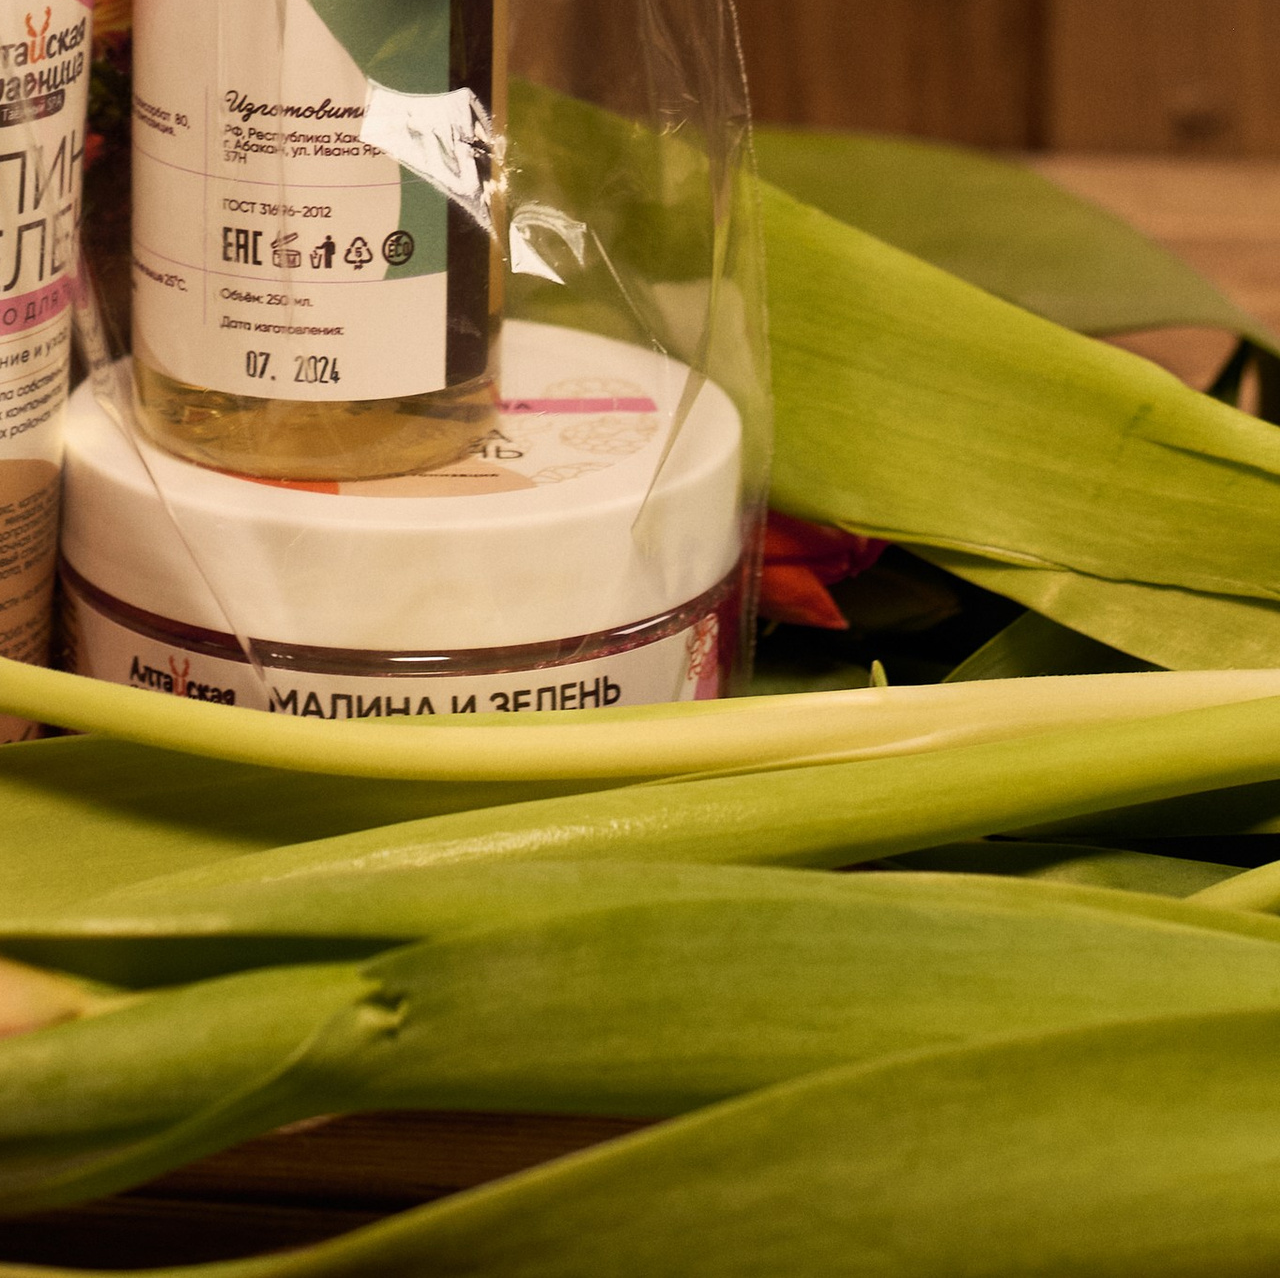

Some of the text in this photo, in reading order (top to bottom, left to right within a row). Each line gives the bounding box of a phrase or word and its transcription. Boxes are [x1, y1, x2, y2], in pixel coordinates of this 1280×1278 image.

[225, 90, 369, 122] Изготовит
[223, 124, 245, 140] РФ,
[292, 146, 310, 159] ул.
[314, 145, 359, 157] Ивана
[223, 197, 257, 213] ГОСТ
[266, 294, 289, 307] 250
[221, 316, 344, 336] Дата изготовления:
[34, 344, 43, 358] и
[246, 350, 341, 384] 07. 2024
